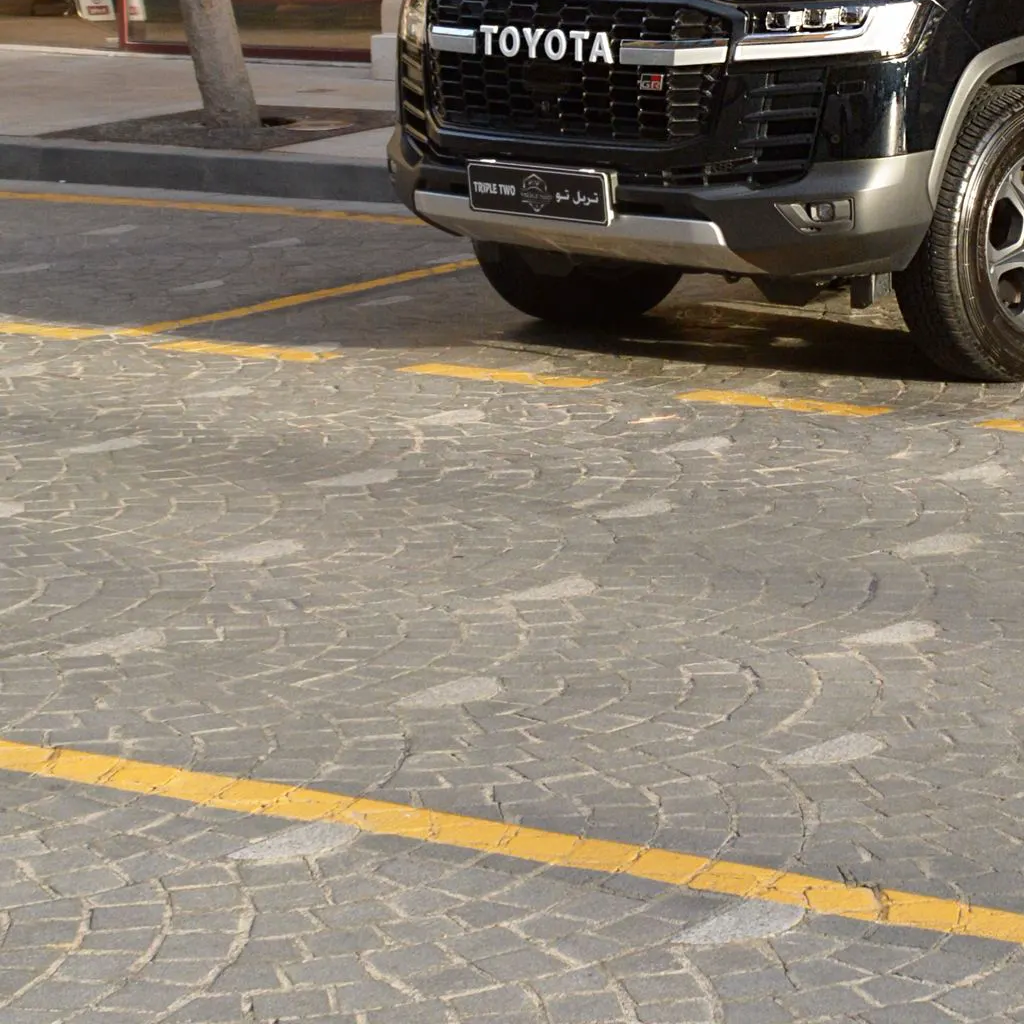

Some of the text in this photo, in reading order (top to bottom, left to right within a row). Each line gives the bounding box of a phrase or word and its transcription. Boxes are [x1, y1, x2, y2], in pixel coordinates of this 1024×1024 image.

[480, 25, 614, 64] TOYOTA
[641, 78, 662, 91] GR
[473, 181, 497, 194] TRIPLE
[498, 184, 516, 196] TWO
[555, 189, 570, 203] تو
[572, 190, 599, 206] تربل
